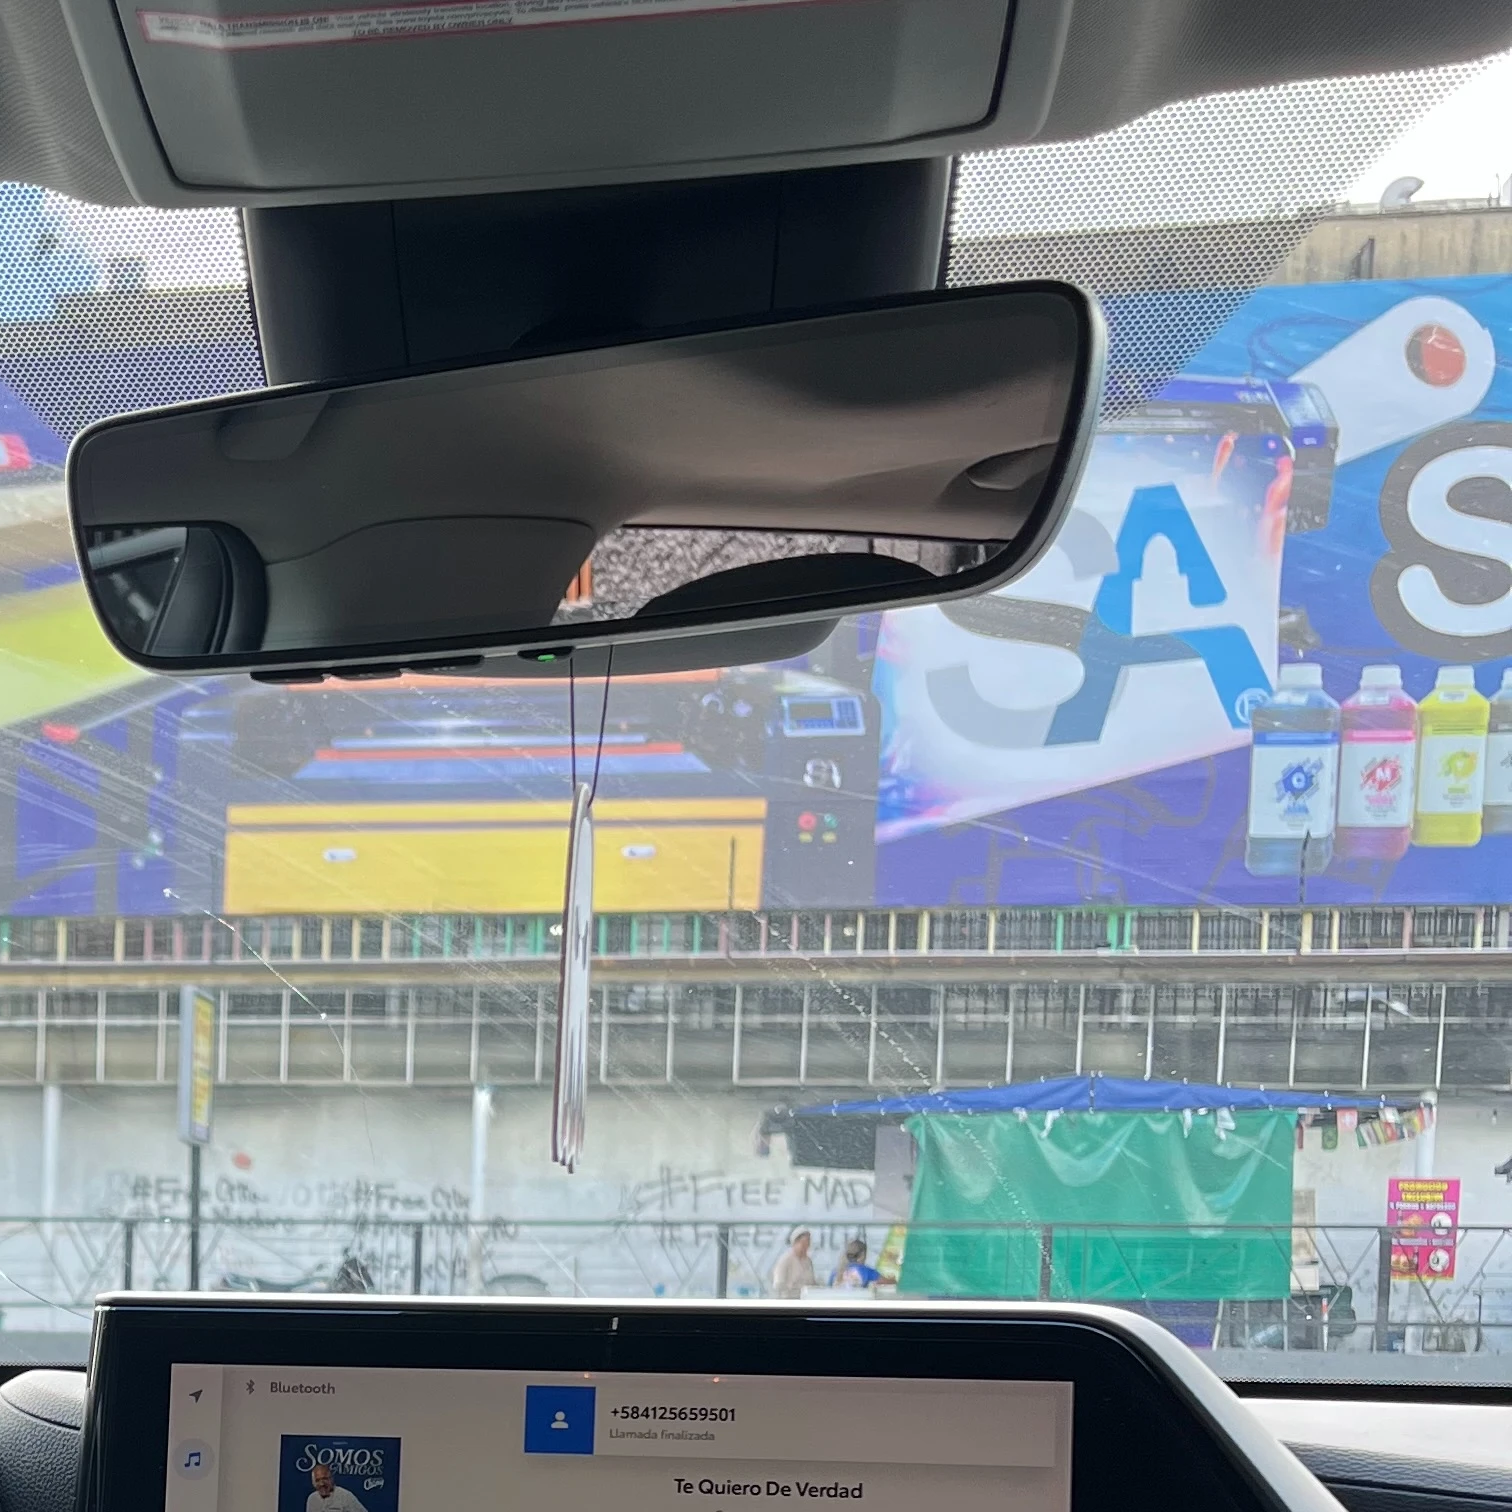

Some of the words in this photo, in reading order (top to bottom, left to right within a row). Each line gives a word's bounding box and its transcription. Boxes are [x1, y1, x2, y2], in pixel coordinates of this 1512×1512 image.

[270, 1381, 336, 1396] Bluetooth
[610, 1406, 736, 1423] +584125659501
[609, 1428, 657, 1441] Llamada
[661, 1429, 716, 1442] finalizada
[296, 1444, 384, 1472] SOMOS
[674, 1479, 693, 1494] Te
[698, 1480, 762, 1498] Quiero
[766, 1482, 791, 1496] De
[796, 1483, 863, 1499] Verdad
